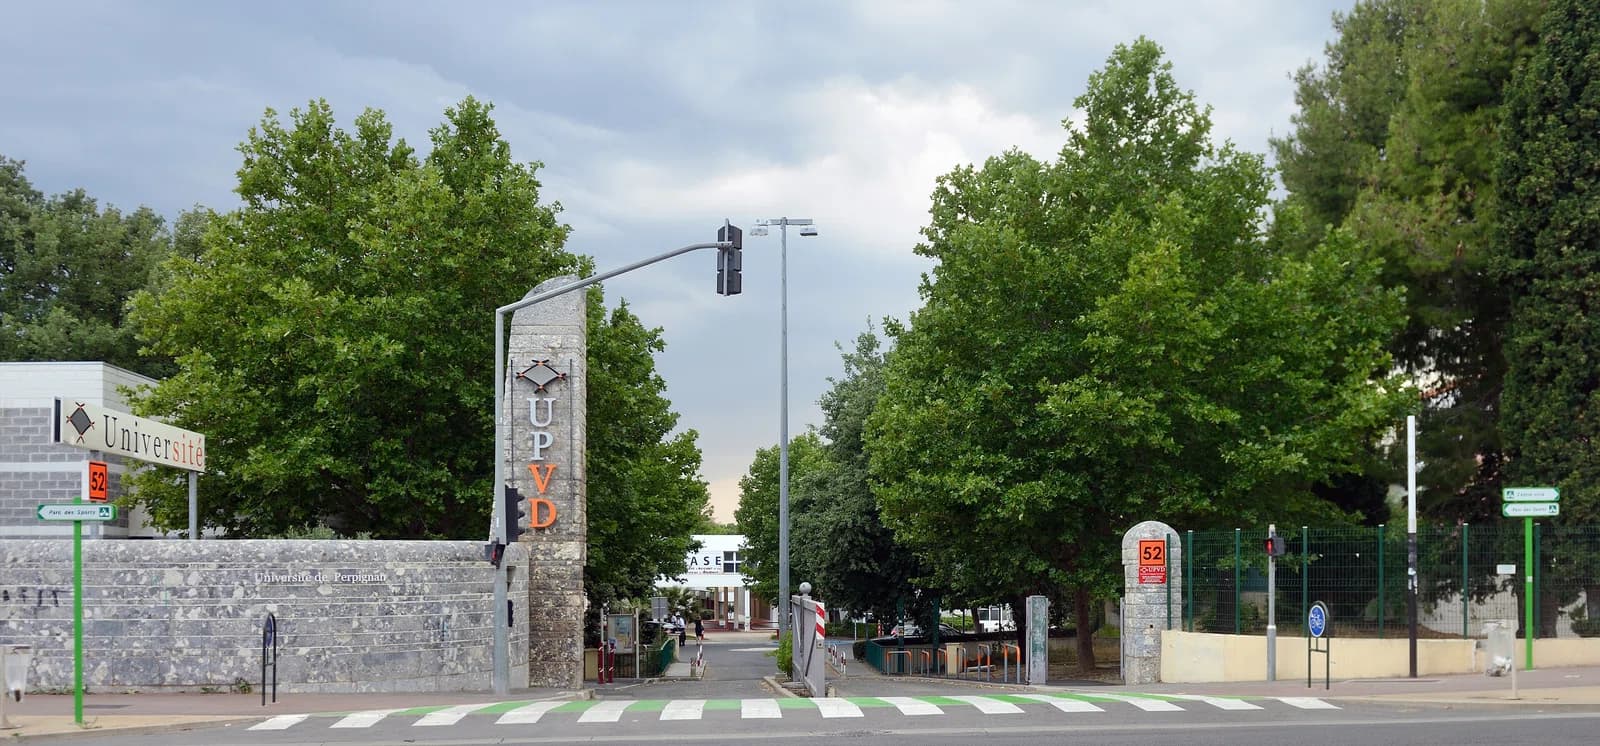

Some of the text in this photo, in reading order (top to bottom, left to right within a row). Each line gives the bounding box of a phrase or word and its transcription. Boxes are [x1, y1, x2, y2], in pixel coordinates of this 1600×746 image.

[103, 414, 203, 467] Université
[527, 397, 557, 529] UPVD
[91, 471, 105, 491] 52
[1143, 546, 1162, 560] 52
[314, 571, 328, 582] de
[334, 571, 386, 584] Perpignan
